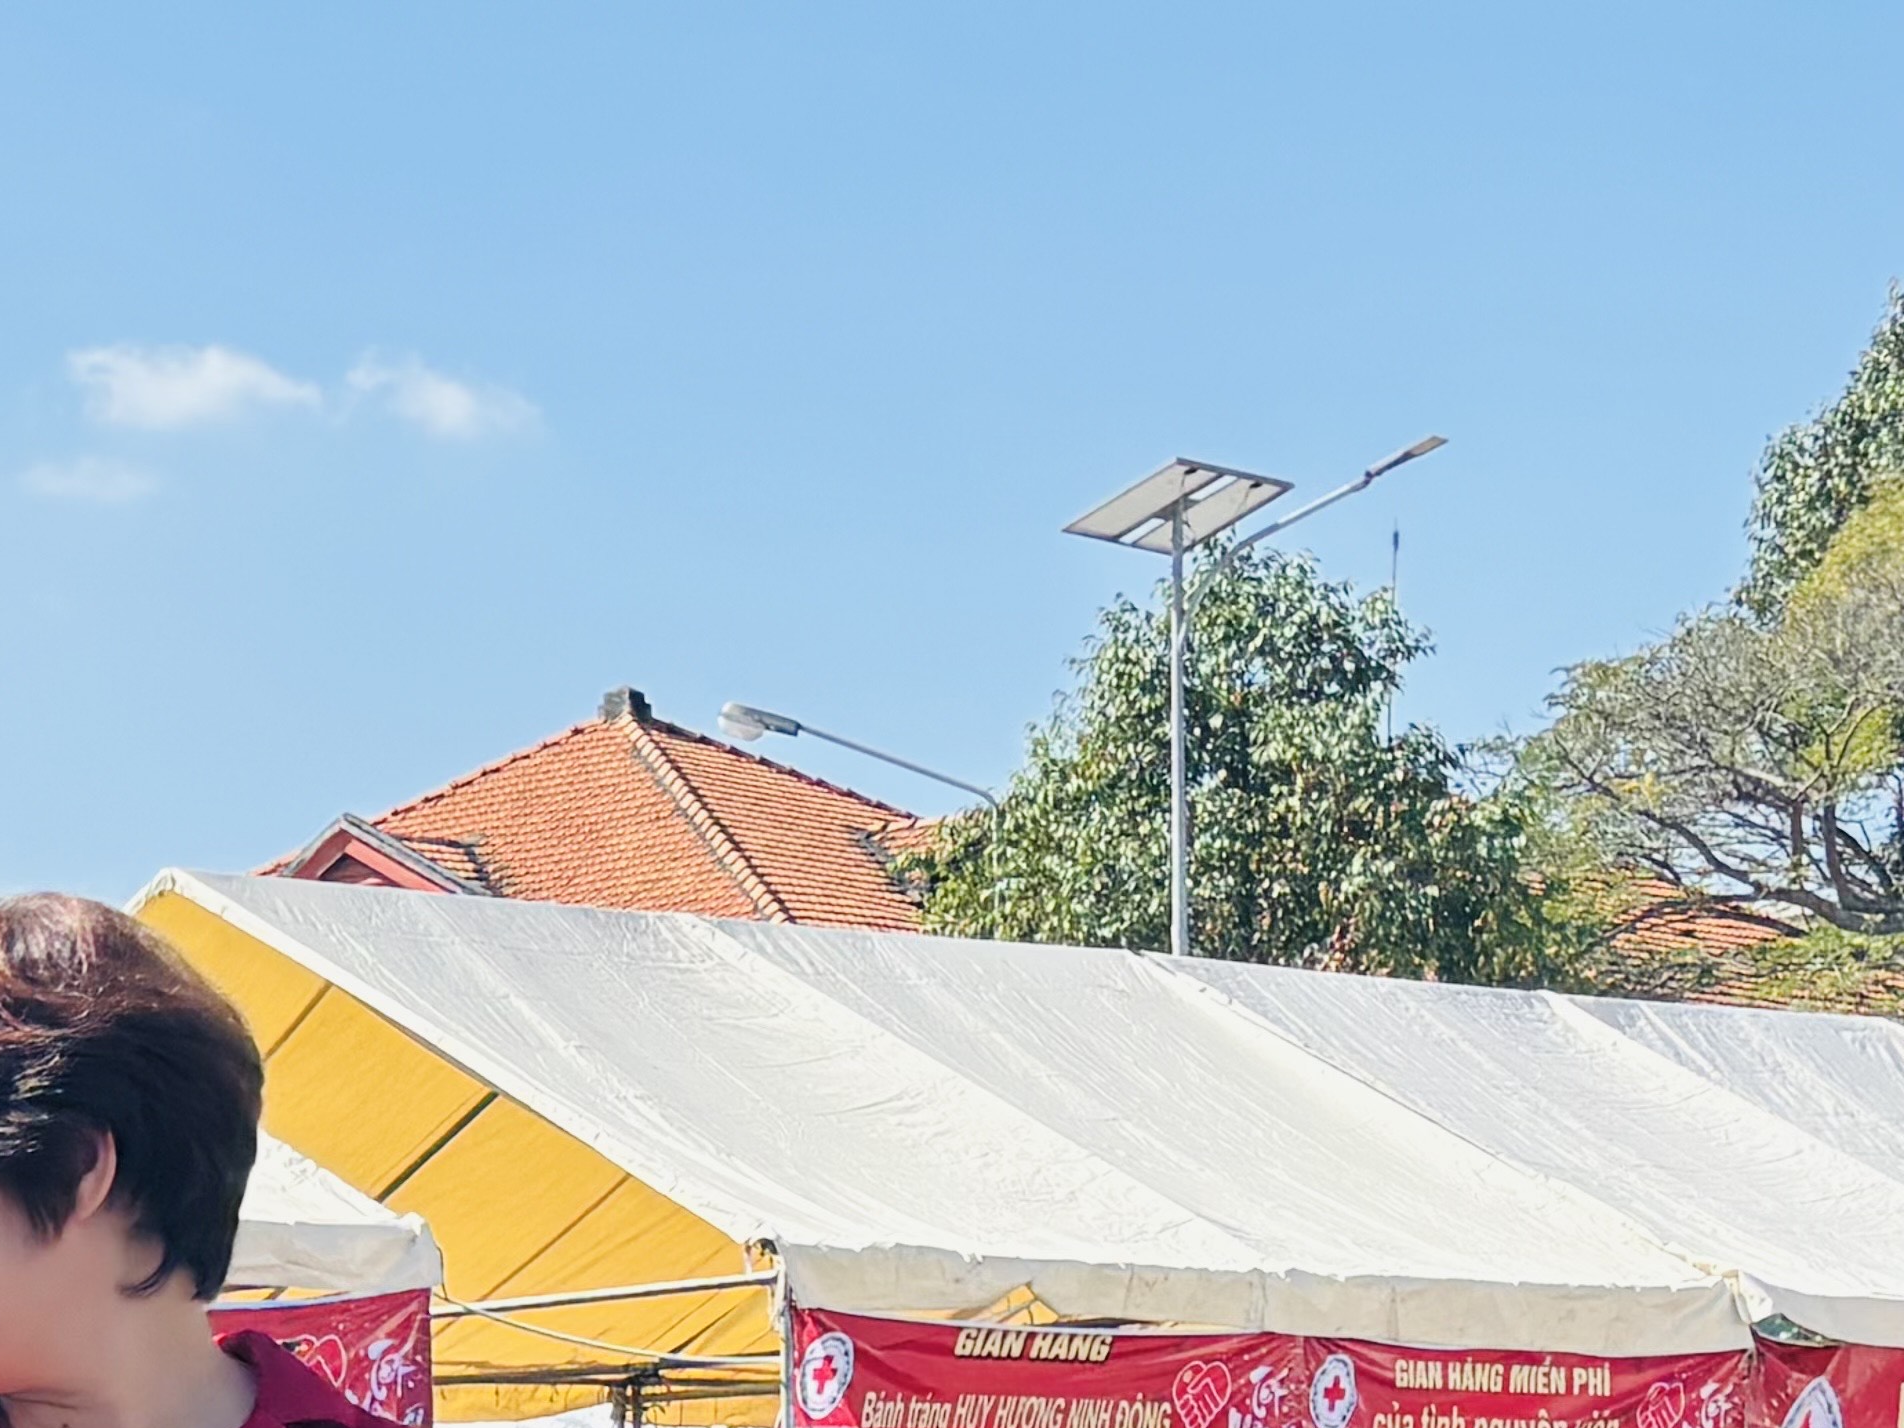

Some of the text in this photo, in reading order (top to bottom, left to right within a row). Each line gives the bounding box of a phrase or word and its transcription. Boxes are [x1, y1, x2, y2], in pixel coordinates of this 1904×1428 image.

[954, 1328, 1026, 1359] GIAN
[1395, 1359, 1444, 1390] GIAN
[1447, 1356, 1505, 1394] HÀNG
[1572, 1361, 1611, 1397] PHÍ
